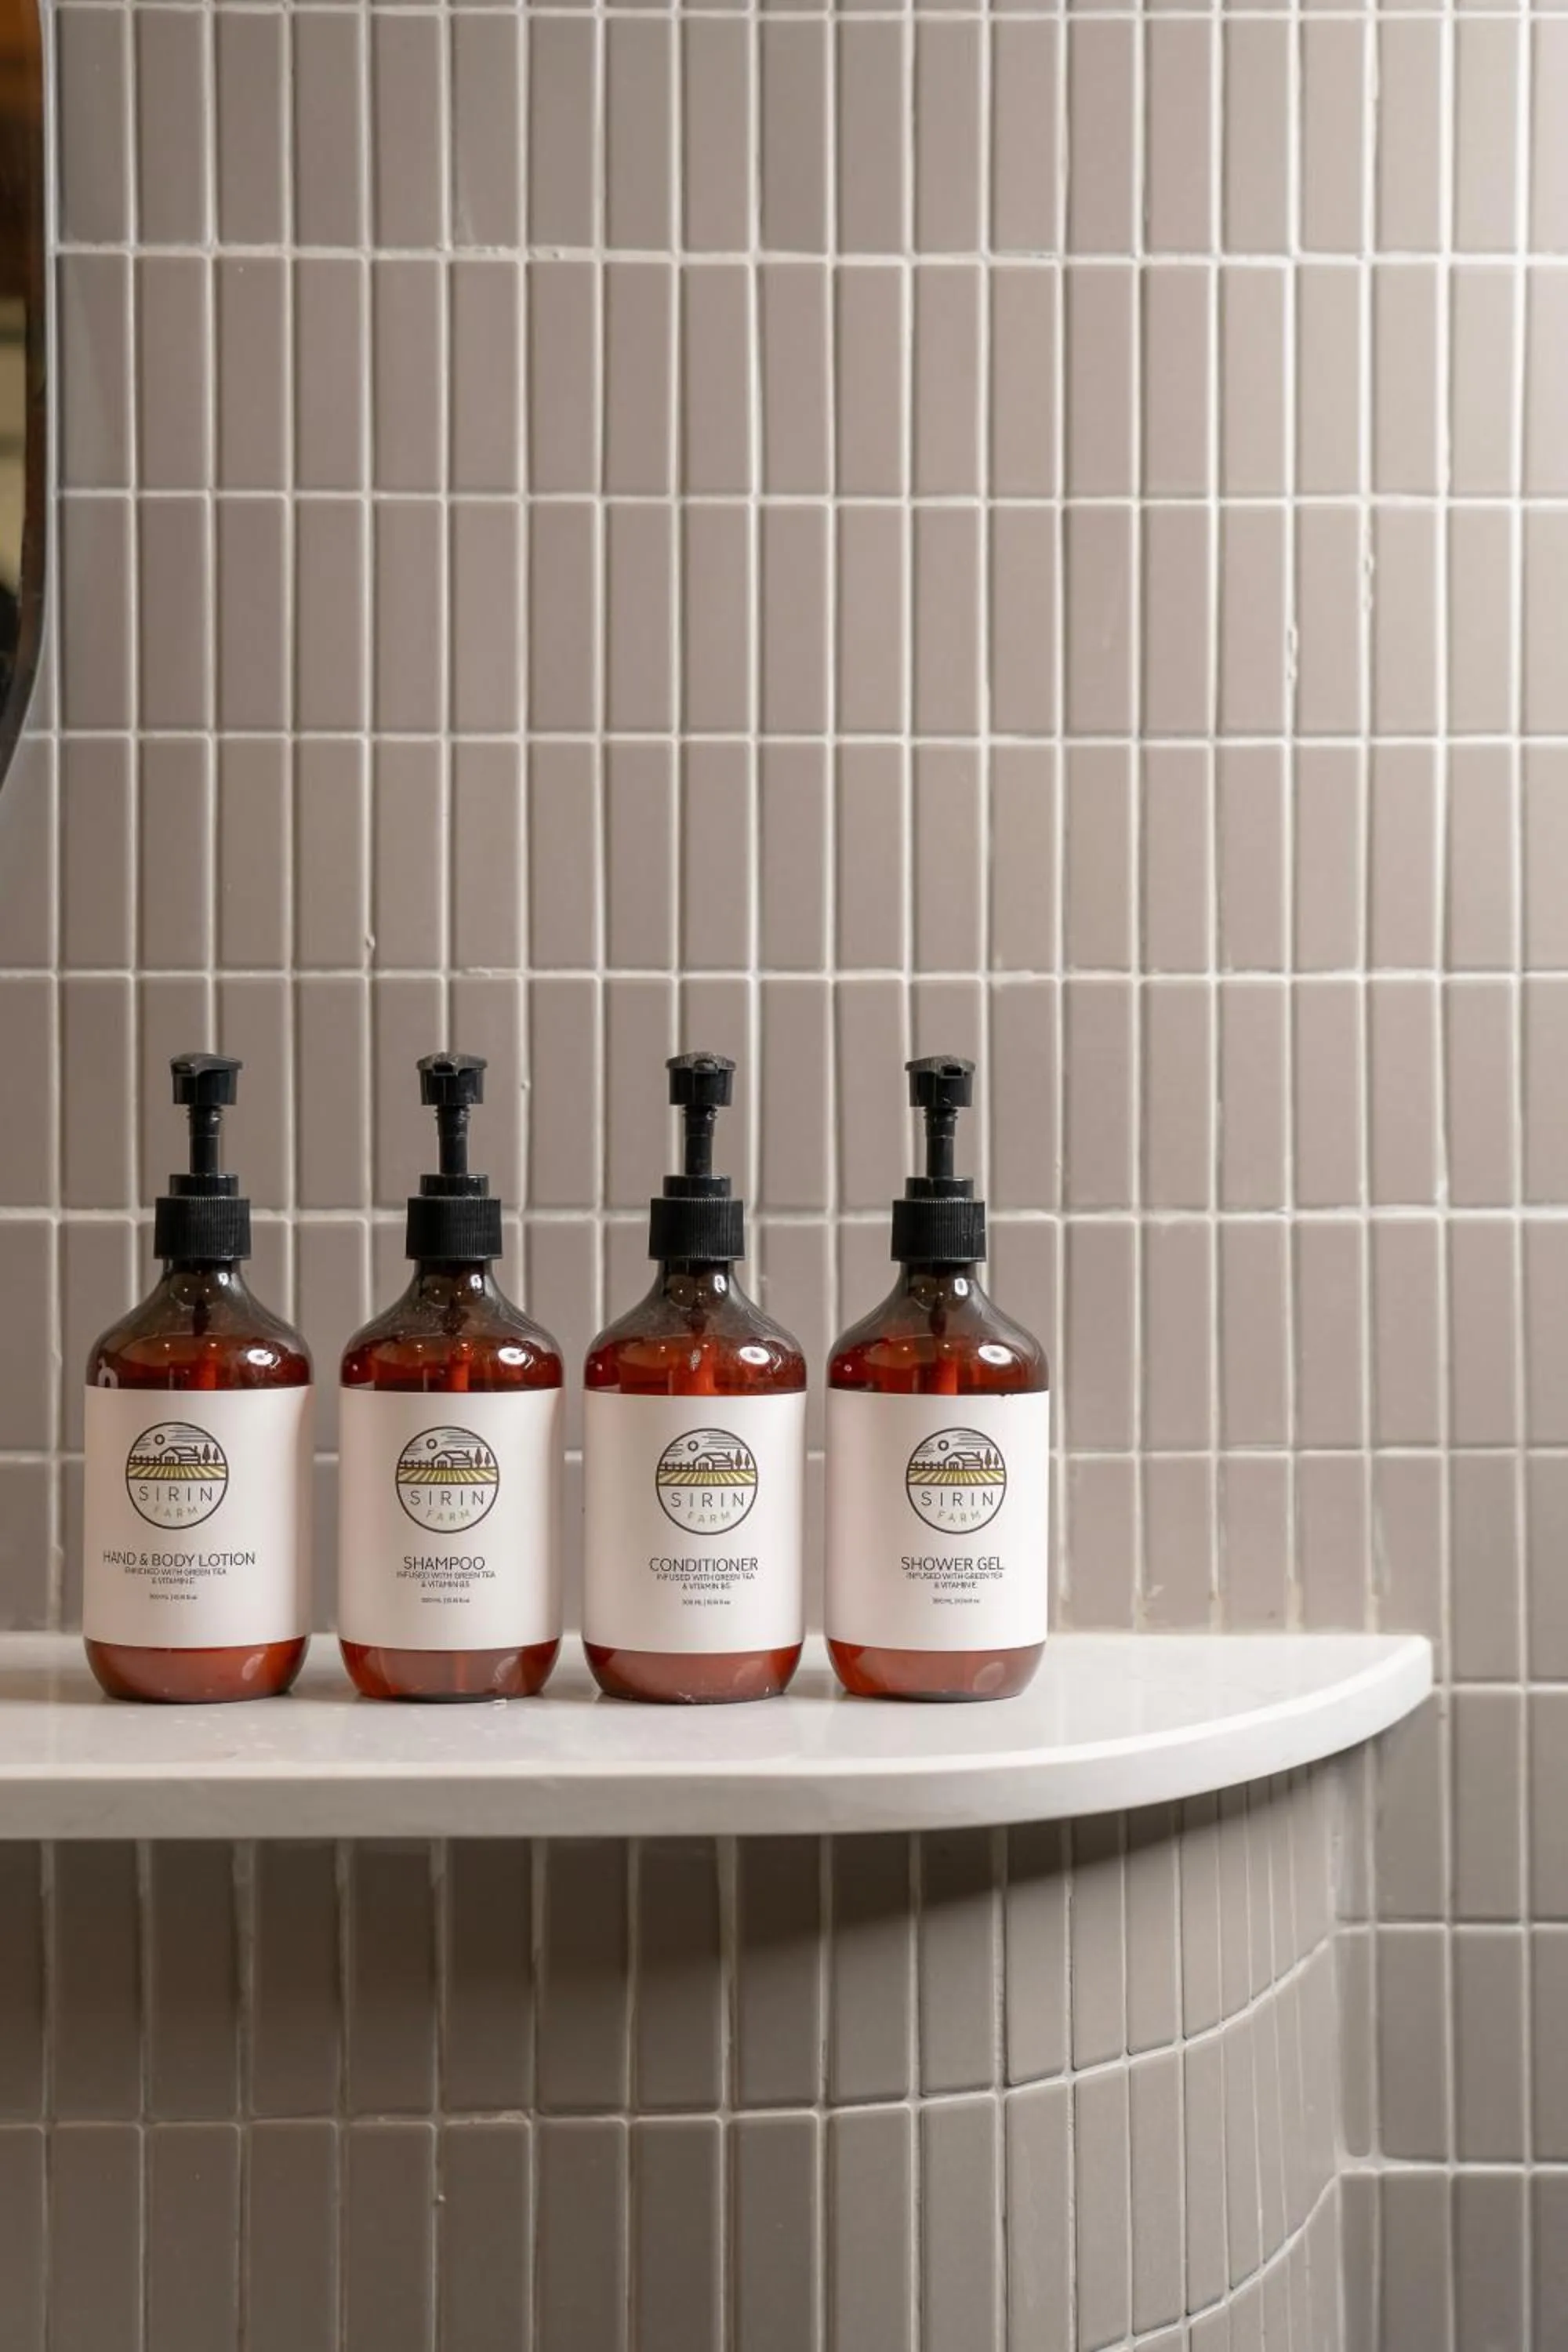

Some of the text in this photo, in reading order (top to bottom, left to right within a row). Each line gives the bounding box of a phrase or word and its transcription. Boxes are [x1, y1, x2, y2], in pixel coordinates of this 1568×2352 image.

[139, 1486, 212, 1501] SIRIN
[409, 1490, 484, 1506] SIRIN
[670, 1492, 744, 1508] SIRIN
[920, 1491, 993, 1506] SIRIN
[153, 1506, 198, 1519] FARM
[426, 1509, 470, 1521] FARM
[688, 1511, 730, 1523] FARM
[938, 1510, 981, 1523] FARM
[103, 1552, 256, 1567] HAND & BODY LOTION
[404, 1556, 485, 1570] SHAMPOO
[650, 1558, 758, 1573] CONDITIONER
[901, 1556, 1004, 1571] SHOWER GEL
[942, 1571, 964, 1580] WITH
